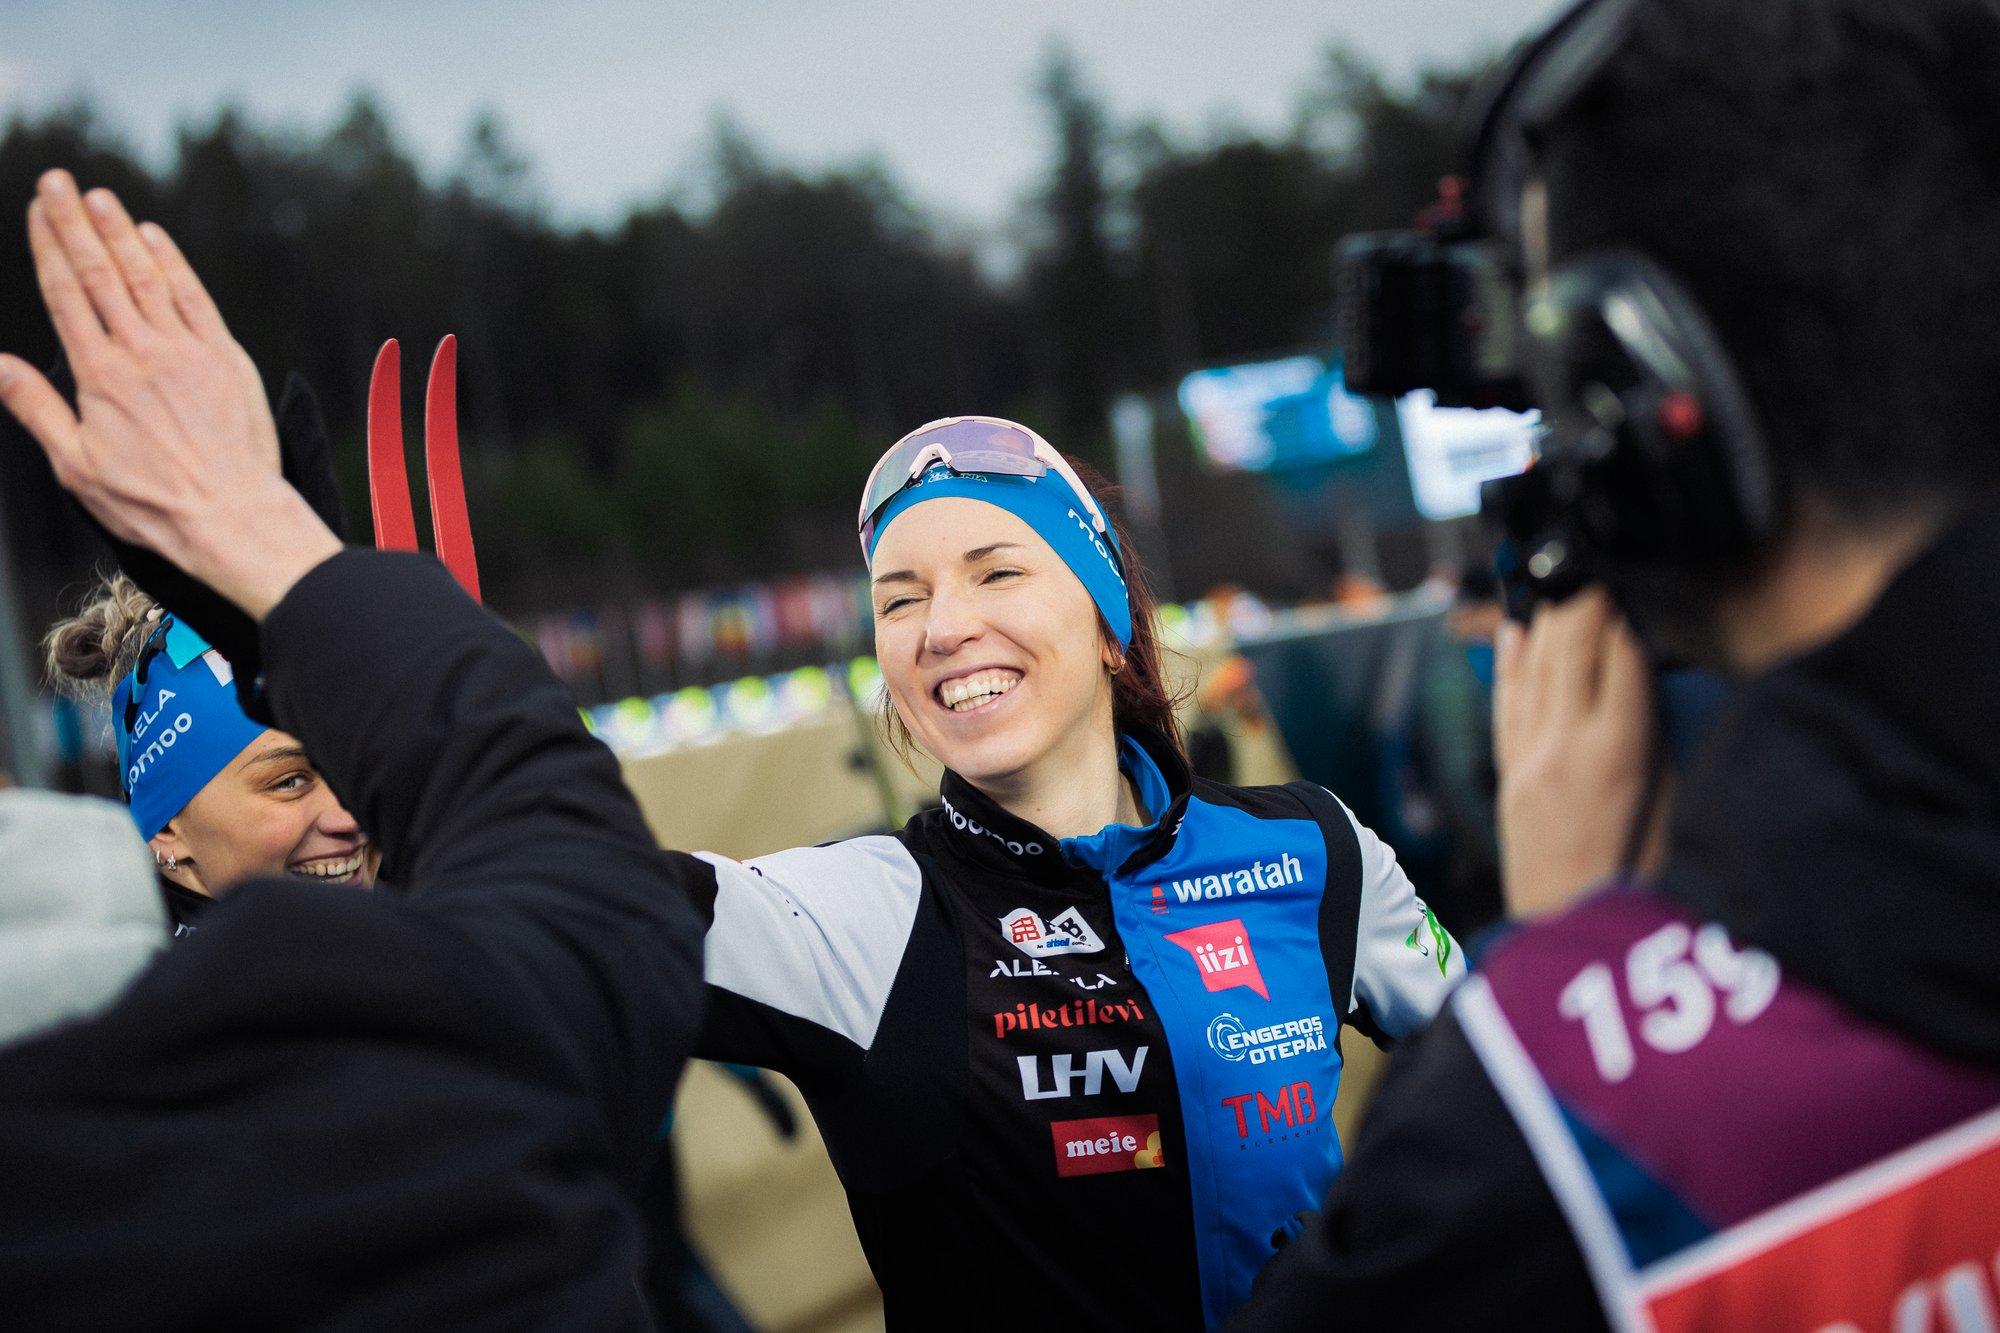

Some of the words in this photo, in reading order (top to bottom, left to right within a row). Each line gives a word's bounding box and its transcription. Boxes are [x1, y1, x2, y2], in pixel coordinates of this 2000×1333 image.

[1172, 852, 1303, 903] waratah
[1195, 935, 1250, 974] iizi
[993, 998, 1145, 1038] piletilevi
[1249, 1030, 1328, 1065] OTEPÄÄ
[1016, 1046, 1149, 1101] LHV
[1221, 1080, 1318, 1139] TMB
[1065, 1131, 1138, 1158] meie
